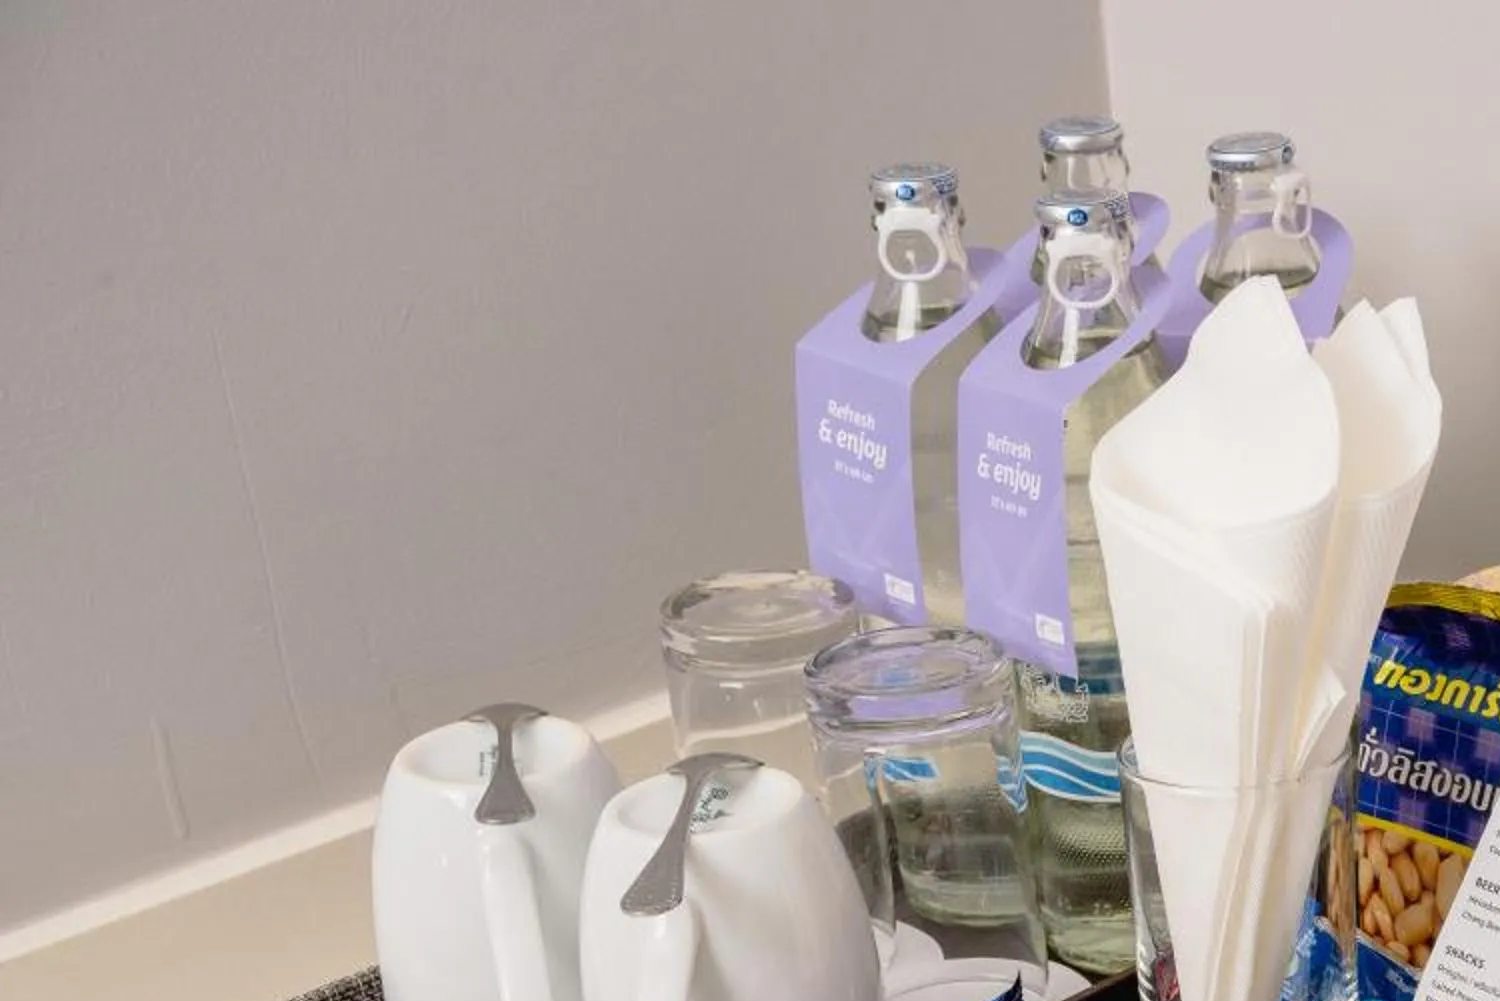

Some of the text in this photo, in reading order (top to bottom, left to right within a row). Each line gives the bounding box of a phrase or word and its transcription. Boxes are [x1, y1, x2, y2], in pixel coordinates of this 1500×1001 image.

[828, 399, 876, 430] Refresh
[818, 418, 887, 470] & enjoy
[987, 432, 1031, 461] Refresh
[977, 453, 1042, 501] & enjoy
[1476, 877, 1500, 895] BEER
[1446, 946, 1485, 969] SNACKS
